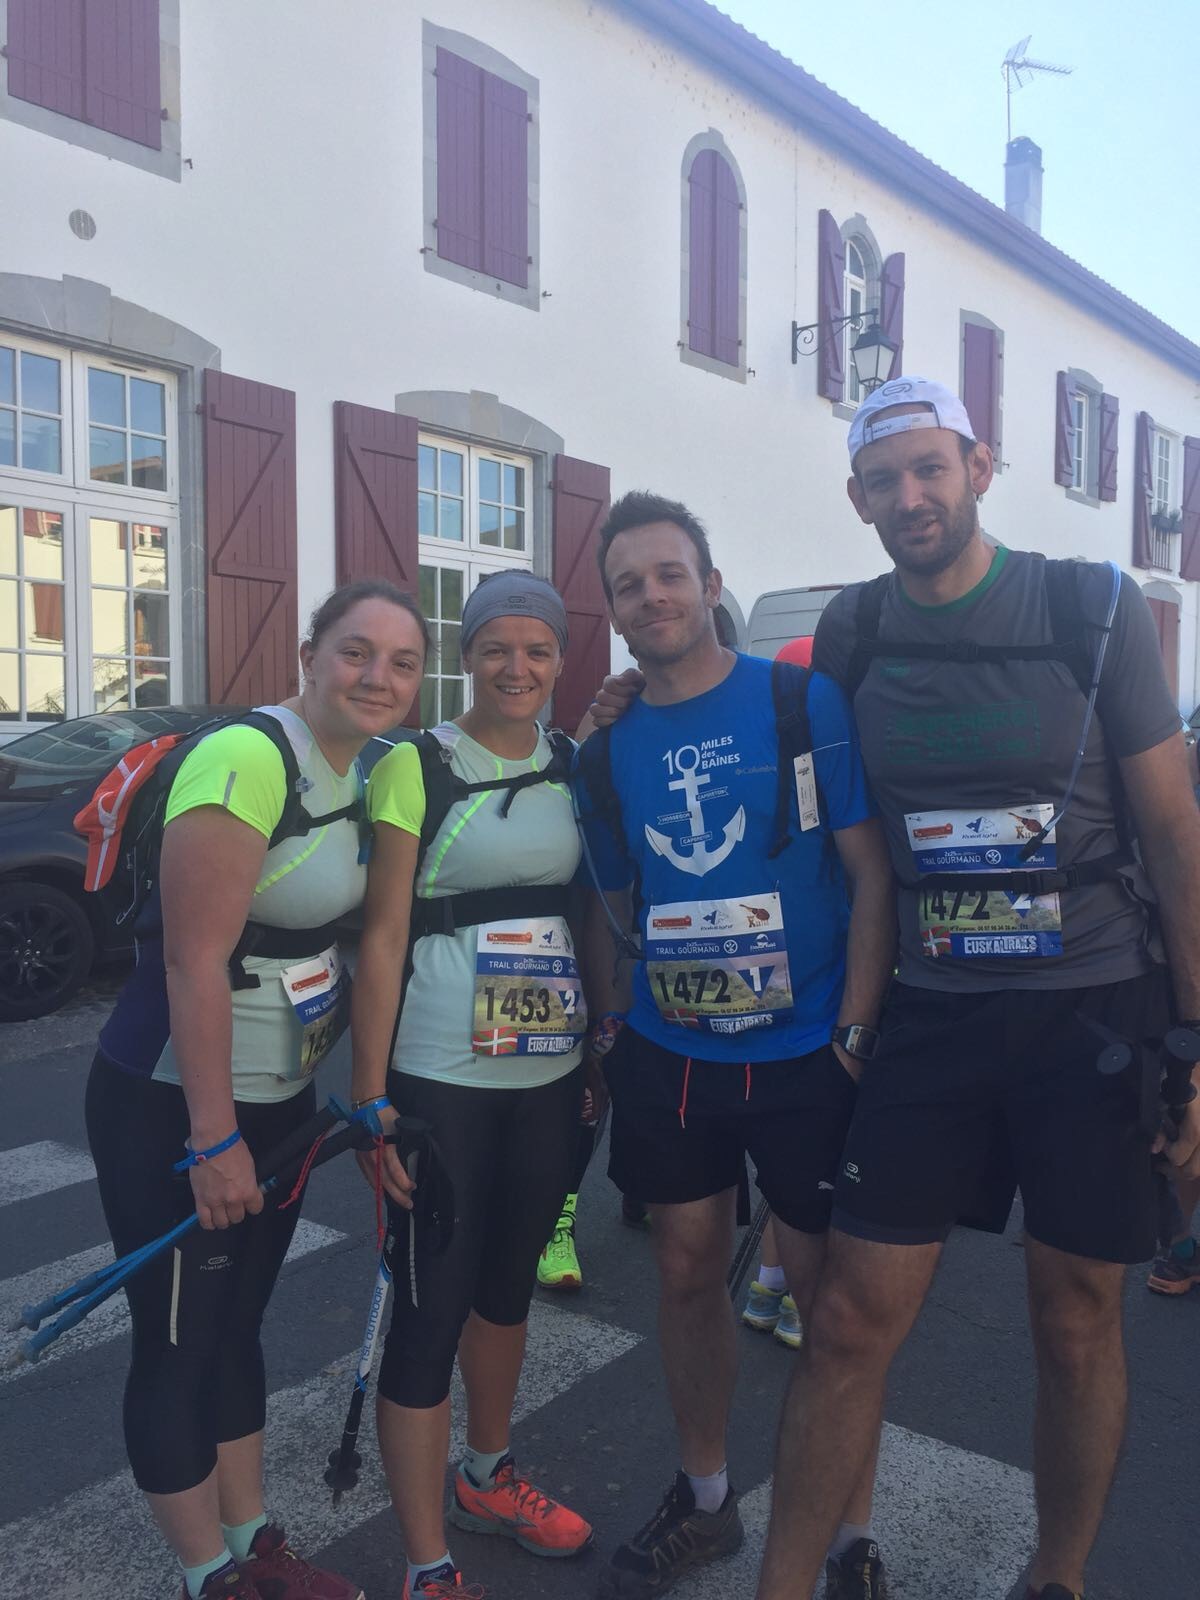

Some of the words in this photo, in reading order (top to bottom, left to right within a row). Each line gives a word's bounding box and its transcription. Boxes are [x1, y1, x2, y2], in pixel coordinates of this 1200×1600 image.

[701, 736, 734, 751] MILES
[662, 745, 700, 775] 10
[701, 750, 716, 759] des
[702, 753, 741, 769] BAÏNES
[921, 857, 936, 865] TRAIL
[936, 855, 981, 864] GOURMAND
[923, 888, 990, 920] 1472
[656, 947, 676, 955] TRAIL
[677, 945, 720, 954] GOURMAND
[489, 960, 511, 970] TRAIL
[513, 961, 550, 971] GOURMAND
[656, 968, 731, 1004] 1472
[749, 966, 762, 992] 1
[304, 1005, 322, 1017] TRAIL
[485, 987, 551, 1023] 1453
[564, 988, 576, 1014] 2
[366, 1286, 384, 1341] OUTDOOR
